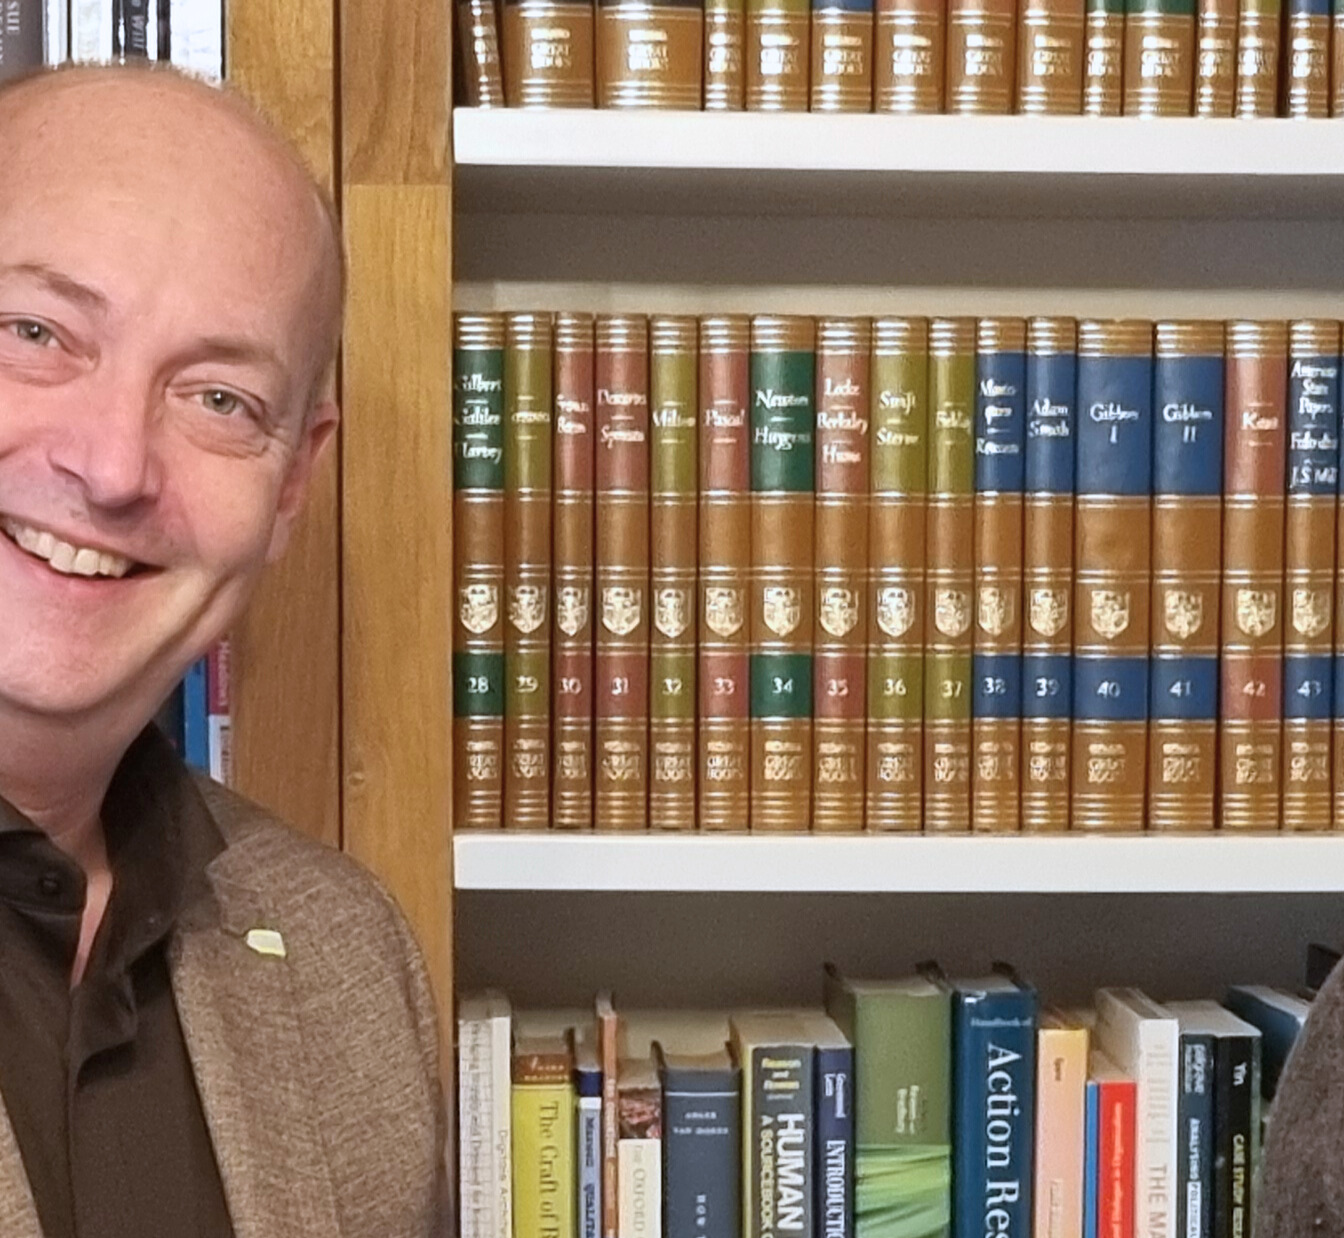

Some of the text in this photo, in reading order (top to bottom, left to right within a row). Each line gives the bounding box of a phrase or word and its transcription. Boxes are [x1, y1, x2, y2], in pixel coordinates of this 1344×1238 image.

[1032, 398, 1069, 416] Adam
[1090, 404, 1138, 420] Gibbon
[1163, 404, 1212, 420] Gibbon
[467, 678, 489, 693] 28
[612, 677, 629, 694] 31
[772, 678, 793, 693] 34
[883, 679, 906, 695] 36
[1096, 681, 1120, 698] 40
[1169, 680, 1191, 695] 41
[1233, 1062, 1247, 1085] Yin
[984, 1043, 1023, 1168] Action
[539, 1102, 560, 1139] The
[539, 1145, 560, 1196] Craft
[777, 1113, 805, 1233] HUMAN
[1148, 1163, 1165, 1205] THE
[540, 1201, 560, 1222] of
